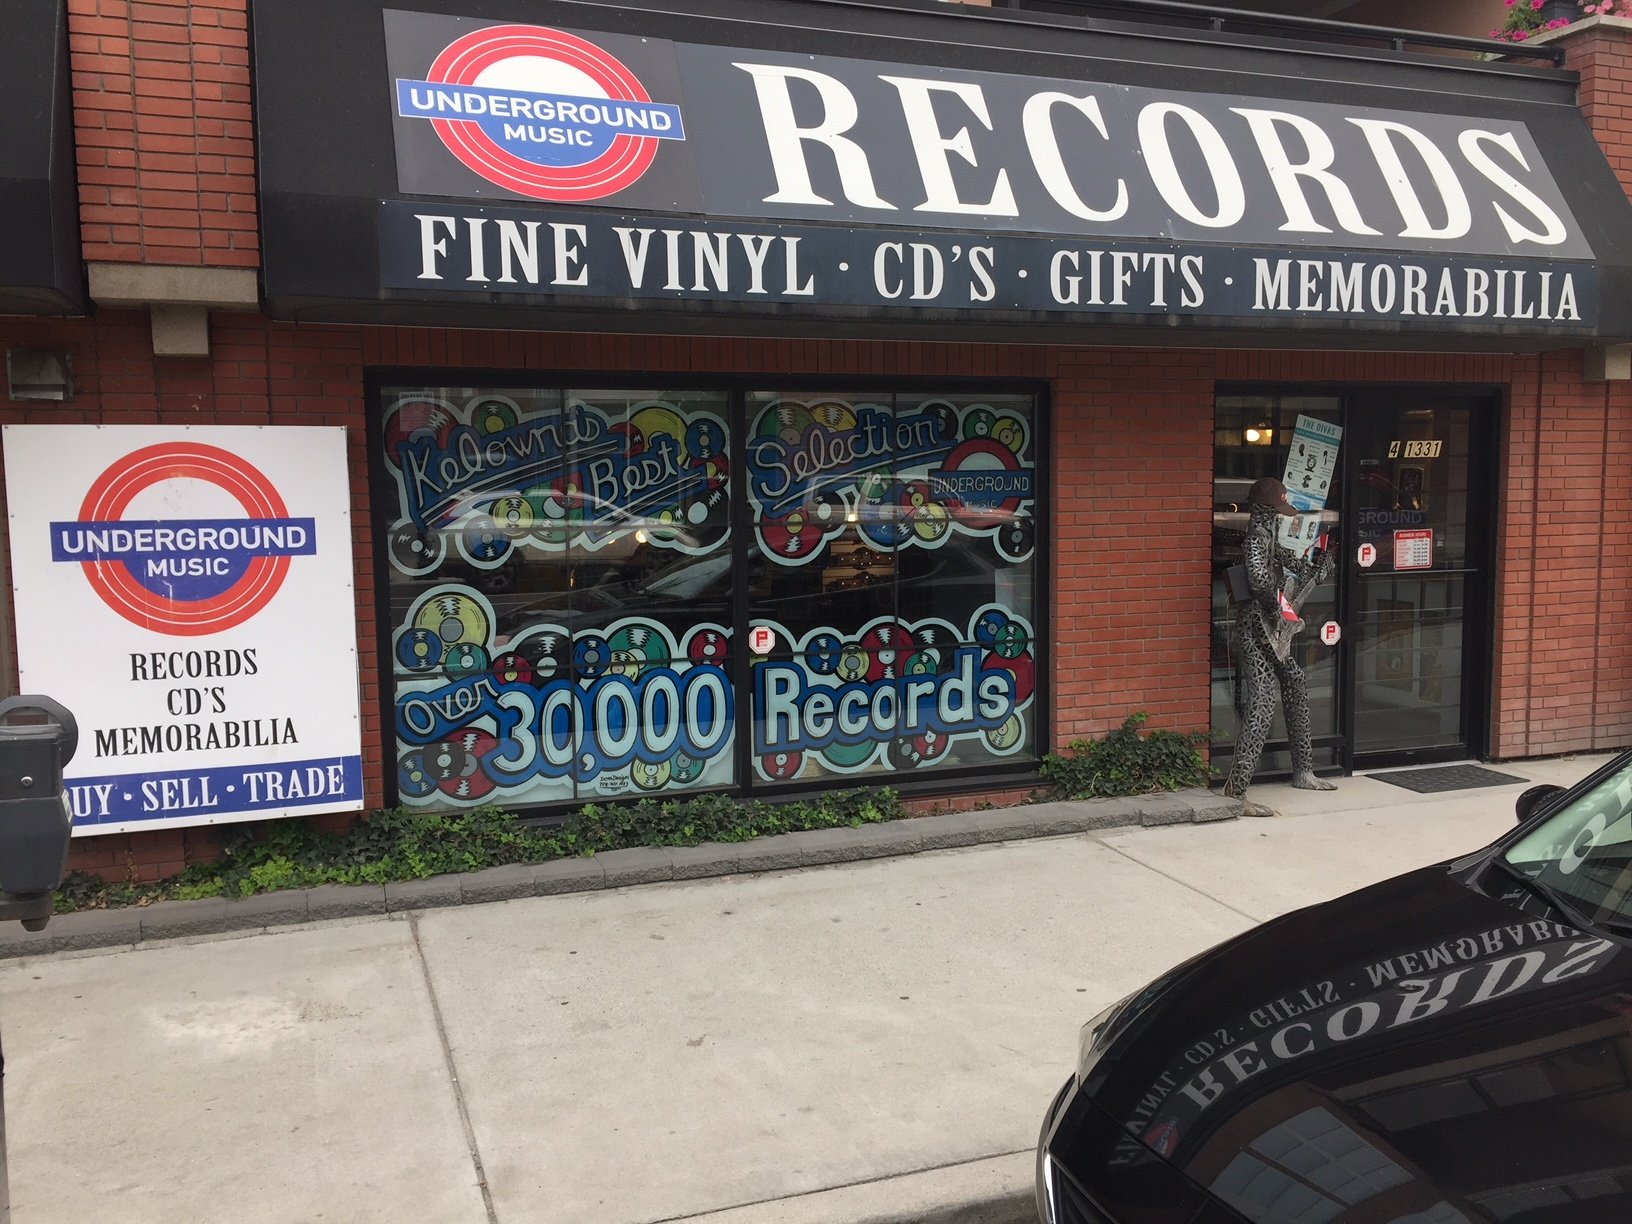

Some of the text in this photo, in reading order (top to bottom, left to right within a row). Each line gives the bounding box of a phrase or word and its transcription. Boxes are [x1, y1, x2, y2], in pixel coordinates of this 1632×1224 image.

[410, 87, 673, 133] UNDERGROUND
[503, 122, 594, 148] MUSIC
[730, 61, 1568, 246] RECORDS
[413, 214, 1582, 321] FINE VINYL CD'S GIFTS MEMORABILIA
[1302, 418, 1336, 436] THE DIVAS
[755, 416, 938, 497] Selection
[1389, 441, 1442, 457] 4 1331
[589, 440, 680, 510] Best
[933, 475, 1029, 494] UNDERGROUND
[965, 499, 998, 508] MUSIC
[1358, 510, 1423, 525] GROUND
[61, 525, 307, 554] UNDERGROUND
[147, 557, 230, 577] MUSIC
[128, 647, 259, 682] RECORDS
[166, 686, 227, 716] CD'S
[403, 678, 501, 735] Over
[764, 654, 1012, 746] Records
[93, 716, 300, 758] MEMORABILIA
[492, 671, 727, 773] 30,000
[70, 763, 345, 817] UY SELL TRADE
